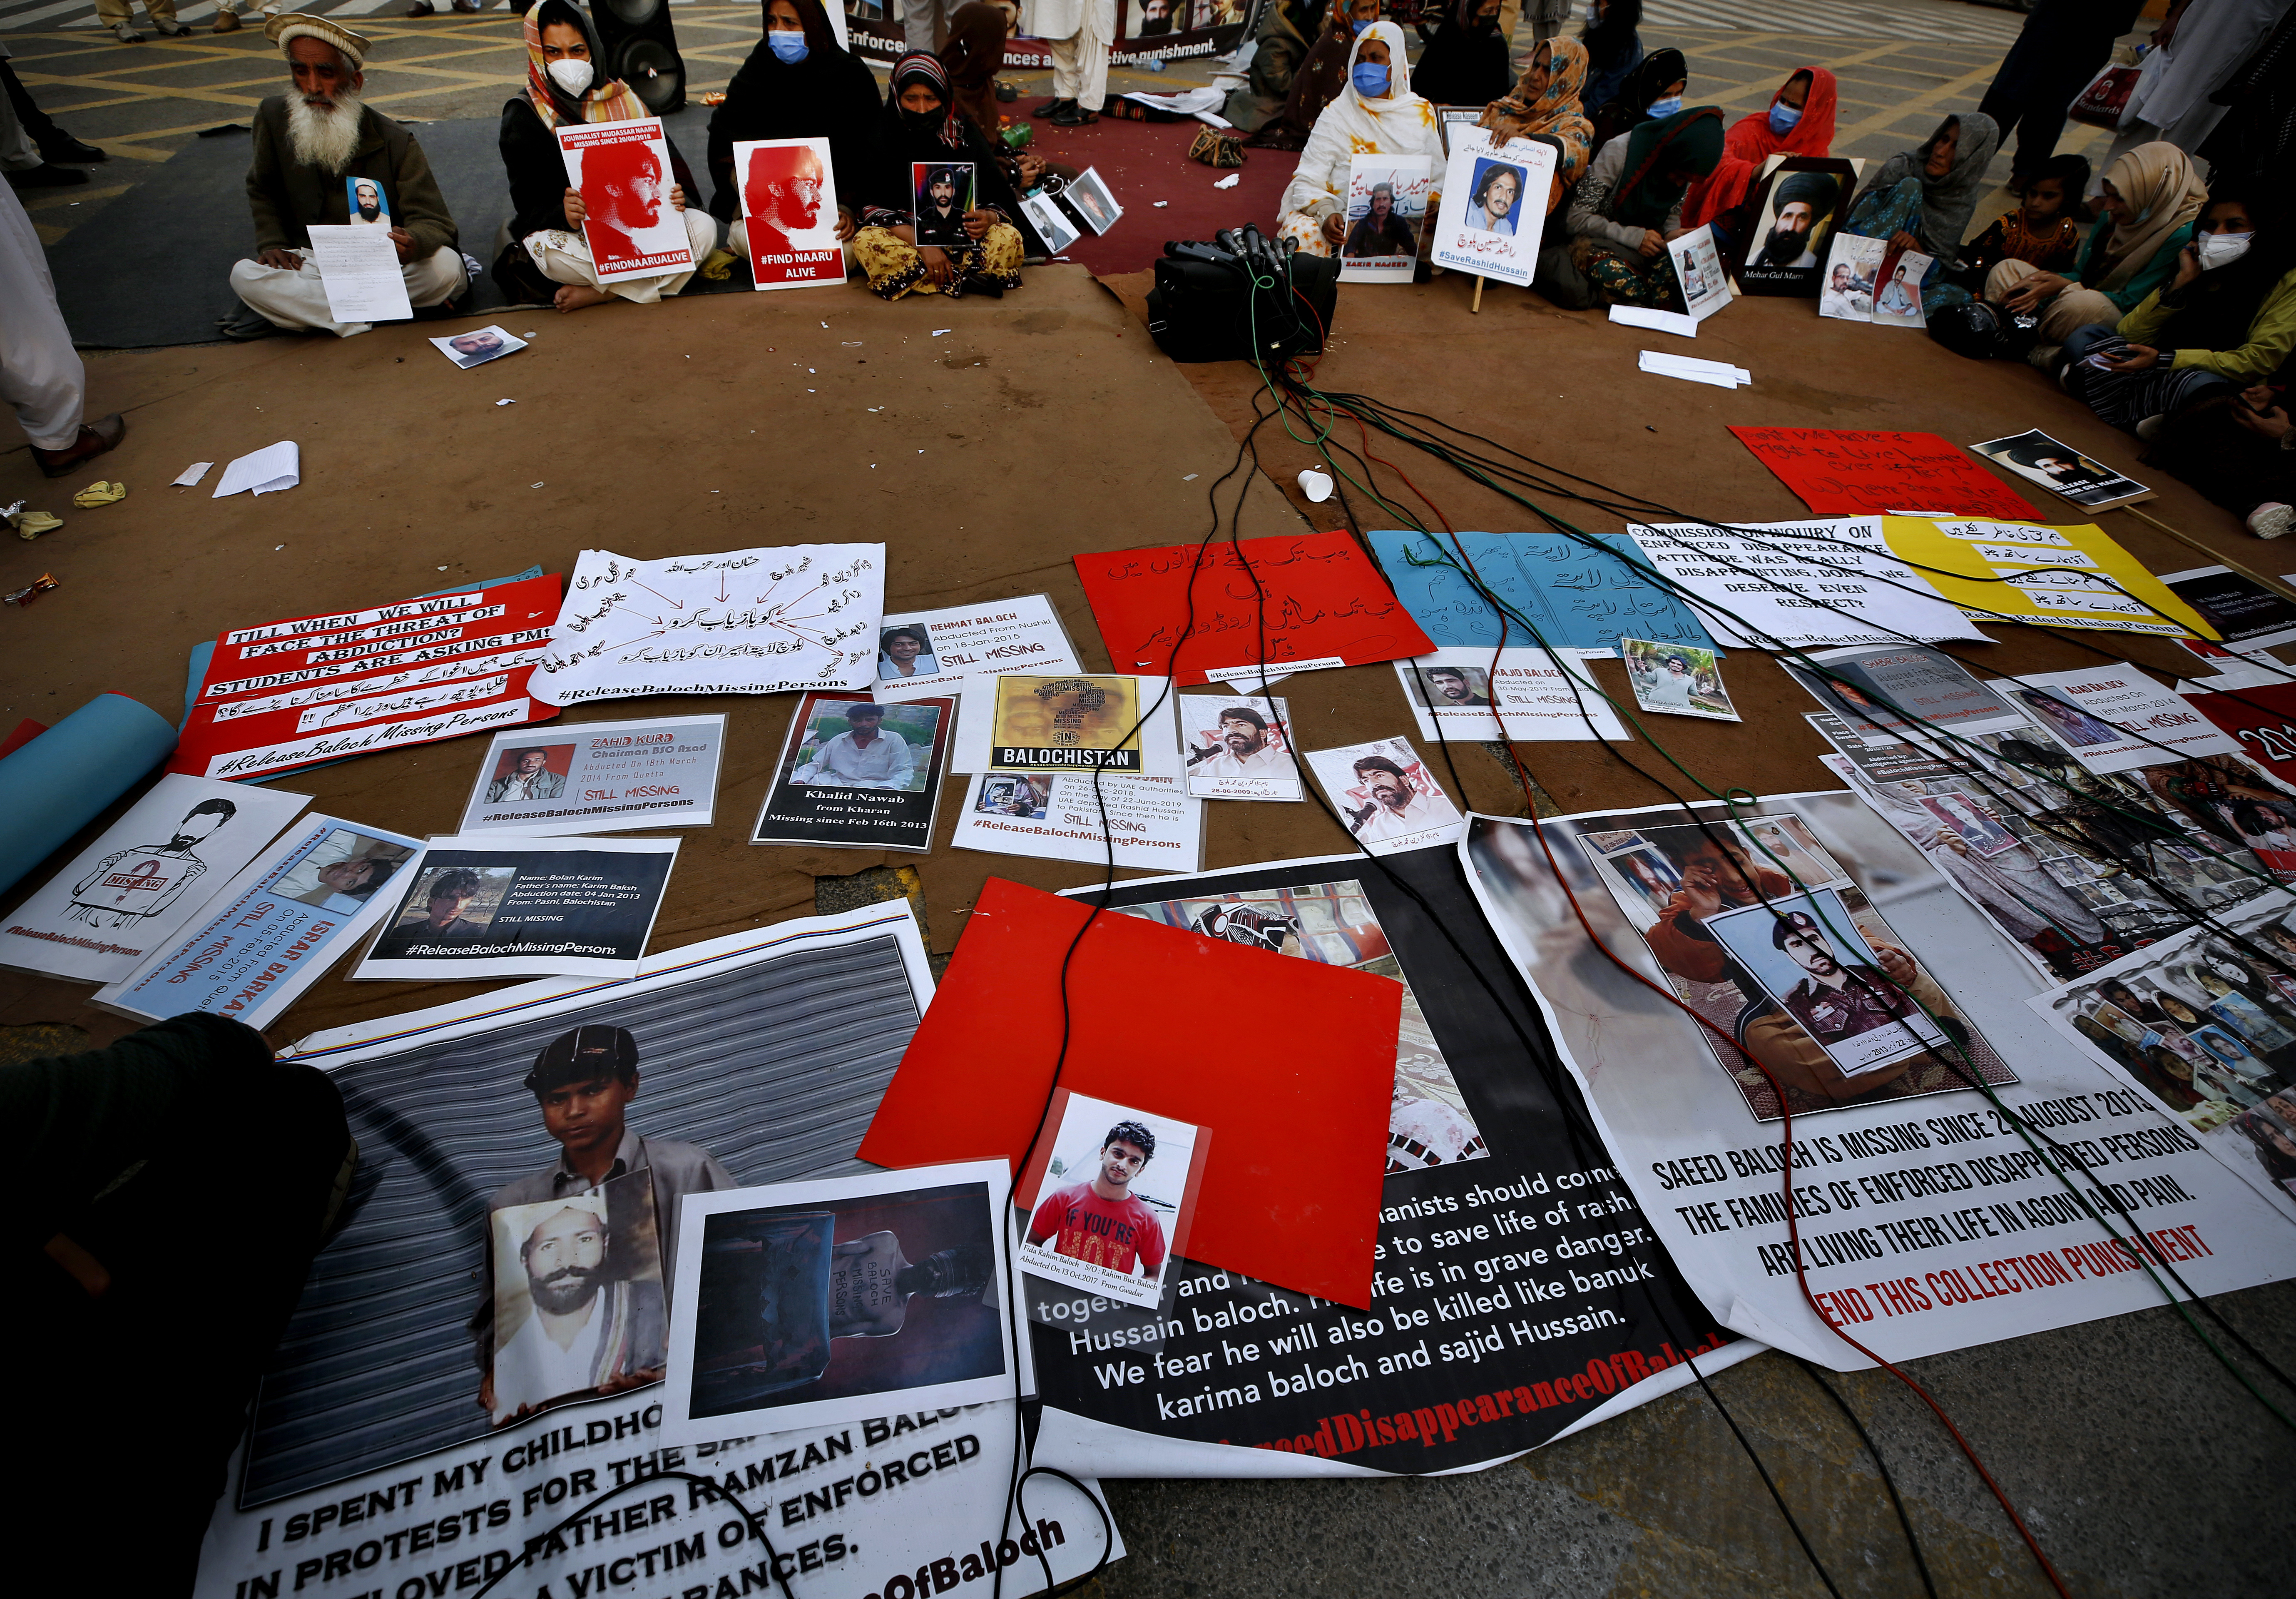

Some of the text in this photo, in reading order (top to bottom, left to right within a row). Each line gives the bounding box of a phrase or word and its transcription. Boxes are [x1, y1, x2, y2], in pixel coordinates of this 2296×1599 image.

[2077, 97, 2120, 114] Standards
[563, 132, 600, 142] JOURNALIST
[601, 128, 634, 137] MUDASSAR
[574, 139, 600, 148] MISSING
[619, 134, 651, 143] 20/08/2018
[1457, 233, 1516, 257] راشد حسین بلوچ
[599, 252, 688, 272] #FINDNAARUALIVE
[761, 252, 833, 264] #FIND NAARU
[1438, 250, 1527, 276] #SaveRashidHussain
[786, 267, 816, 278] ALIVE
[1632, 527, 1738, 538] COMMISSION
[1849, 526, 1873, 538] ON
[1640, 540, 1731, 550] ENFORCED
[1819, 584, 1868, 594] EVEN
[233, 597, 473, 644] TILL WHEN WE WILL
[931, 612, 1018, 632] REHMAT BALOCH
[933, 618, 1052, 642] Abducted From Nushki
[954, 633, 1020, 649] 18-Jan-2015
[210, 628, 551, 696] STUDENTS ARE ASKING PM!
[941, 643, 1045, 667] STILL MISSING
[1862, 655, 1933, 669] SHABIR BALOCH
[1492, 667, 1564, 679] MAJID BALOCH
[558, 679, 848, 700] #ReleaseBalochMissingPersons
[2065, 680, 2129, 695] ASAD BALOCH
[1507, 694, 1579, 705] STILL MISSING
[1914, 690, 1981, 706] STILL MISSING
[2096, 698, 2176, 716] 18th March 2014
[590, 733, 674, 749] ZAHID KURD
[592, 743, 707, 759] Chairman BSO Azad
[1004, 749, 1129, 765] BALOCHISTAN
[1861, 760, 1897, 768] Intelligence
[584, 785, 680, 802] STILL MISSING
[804, 790, 905, 804] Khalid Nawab
[1139, 786, 1183, 795] authorities
[482, 798, 694, 822] #ReleaseBalochMissingPersons
[847, 806, 891, 814] Kharan
[769, 814, 813, 824] Missing
[1063, 813, 1092, 827] STILL
[562, 899, 616, 907] Balochistan
[5, 926, 142, 956] #ReleaseBalochMissingPersons
[167, 902, 275, 985] STILL MISSING
[280, 919, 336, 961] ISRAR
[405, 942, 616, 956] #ReleaseBalochMissingPersons
[1652, 1154, 1729, 1191] SAEED
[1725, 1140, 1818, 1179] BALOCH
[1811, 1136, 1844, 1164] IS
[1837, 1121, 1931, 1160] MISSING
[1925, 1111, 1995, 1146] SINCE
[2019, 1095, 2102, 1130] AUGUST
[1065, 1208, 1136, 1245] IF YOU'RE
[1024, 1245, 1158, 1291] Fida Rahim Baloch S/O Rahim Bux Baloch
[852, 1269, 863, 1309] MISSING
[867, 1262, 878, 1306] BALOCH
[880, 1269, 892, 1305] SAVE
[1813, 1287, 1874, 1328] END
[1865, 1275, 1933, 1318] THIS
[1925, 1250, 2075, 1306] COLLECTION
[833, 1270, 848, 1316] PERSONS
[1093, 1361, 1145, 1390] We
[1154, 1350, 1214, 1380] fear
[1222, 1340, 1261, 1367] he
[1268, 1322, 1318, 1356] will
[1327, 1315, 1384, 1345] also
[1390, 1306, 1430, 1332] be
[1433, 1284, 1512, 1322] killed
[1514, 1277, 1567, 1305] like
[686, 1429, 853, 1512] RAMZAN
[781, 1434, 983, 1528] ENFORCED
[256, 1455, 492, 1553] I SPENT MY
